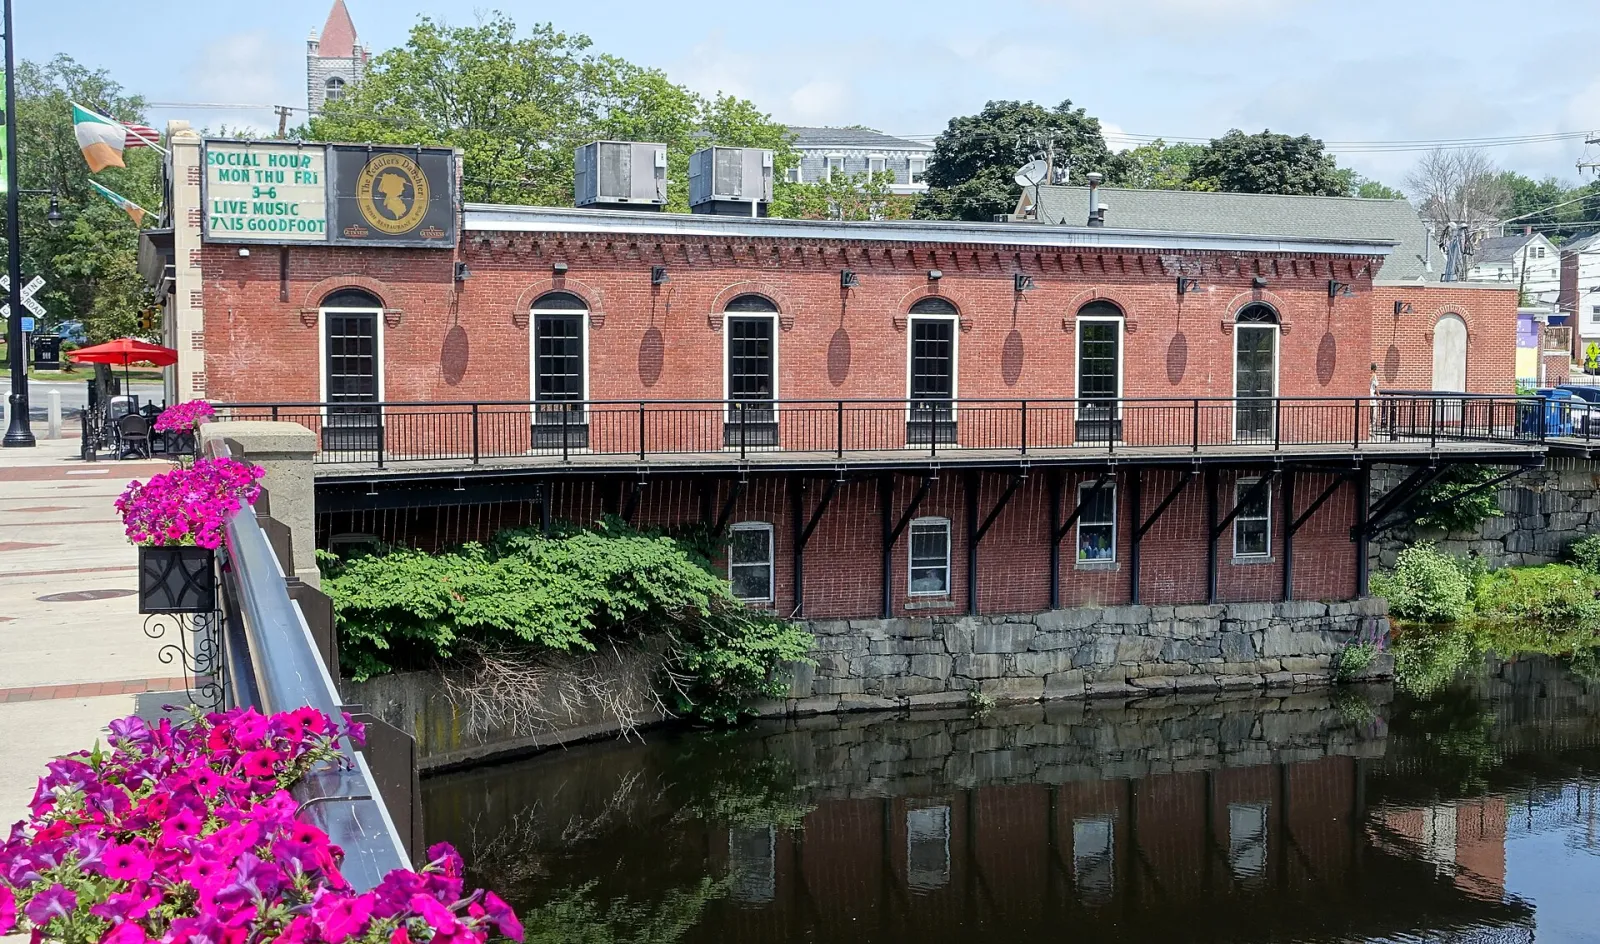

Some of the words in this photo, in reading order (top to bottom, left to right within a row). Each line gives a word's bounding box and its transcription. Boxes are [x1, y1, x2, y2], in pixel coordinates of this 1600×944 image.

[207, 152, 260, 166] SOCIAL
[268, 154, 312, 168] HOUR
[219, 169, 250, 182] MON
[255, 170, 284, 183] THU
[361, 179, 371, 195] The
[401, 160, 424, 196] Daughter
[214, 200, 247, 214] LIVE
[253, 202, 299, 216] MUSIC
[248, 218, 326, 232] GOODFOOT
[377, 219, 412, 230] RESTAURANT
